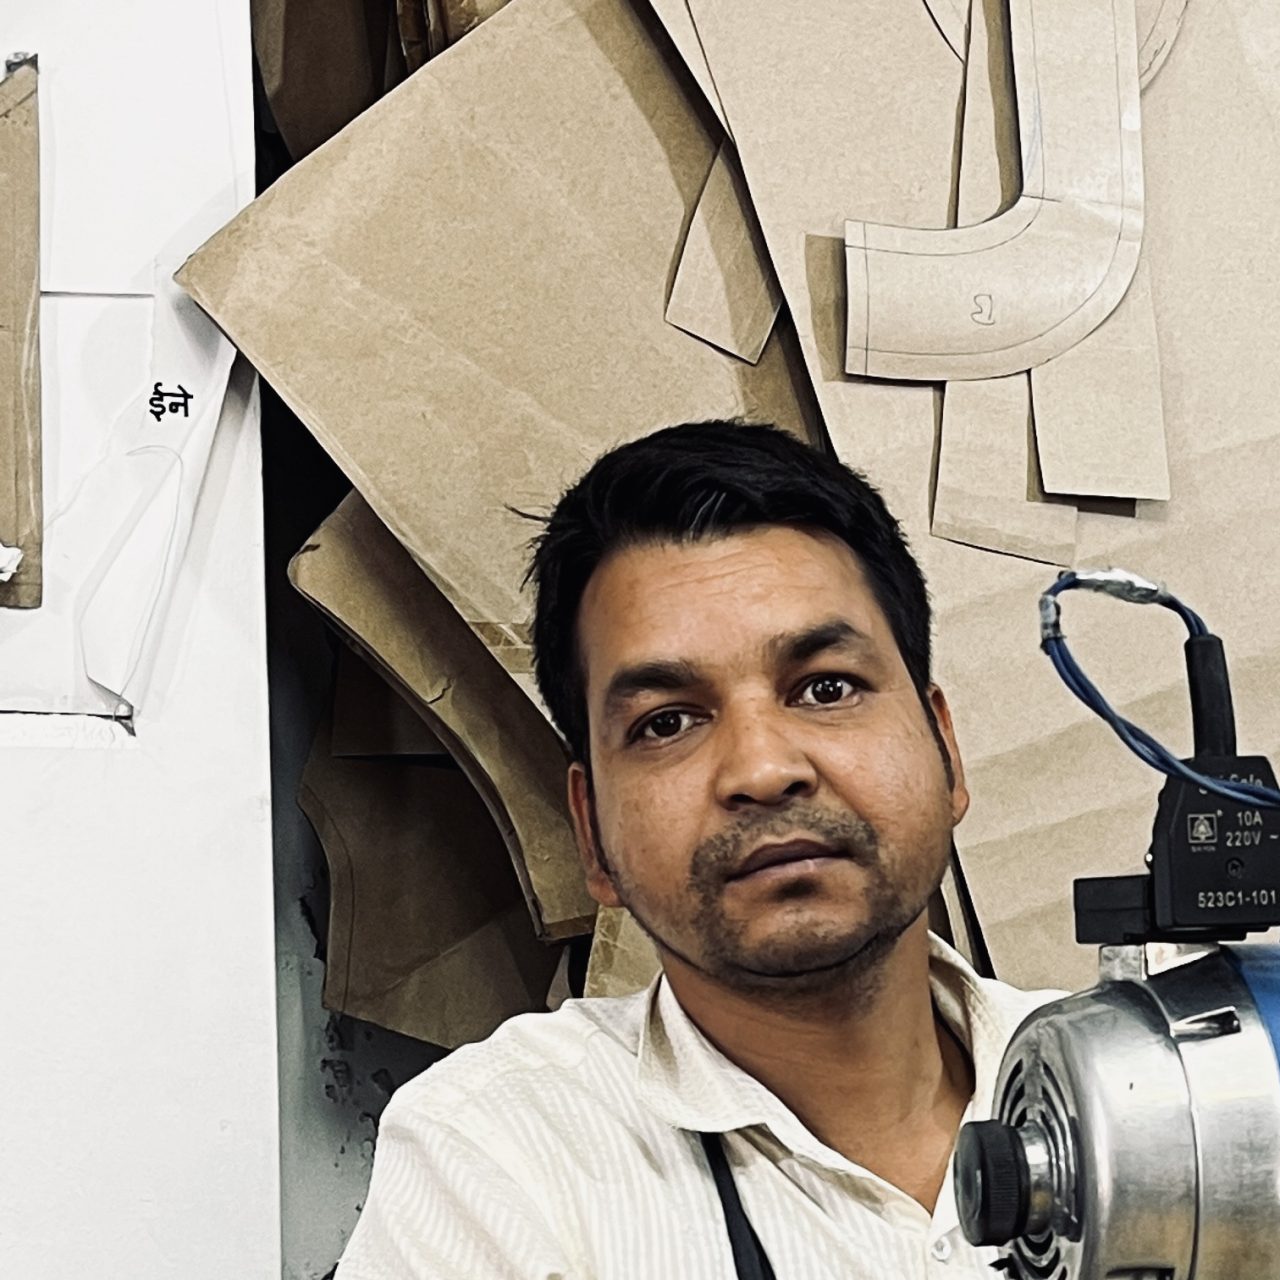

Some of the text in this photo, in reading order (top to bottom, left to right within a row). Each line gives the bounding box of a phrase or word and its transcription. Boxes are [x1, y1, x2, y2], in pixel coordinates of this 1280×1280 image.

[1237, 810, 1263, 827] 10A
[1225, 830, 1262, 848] 220V
[1198, 889, 1277, 908] 523C1-101
